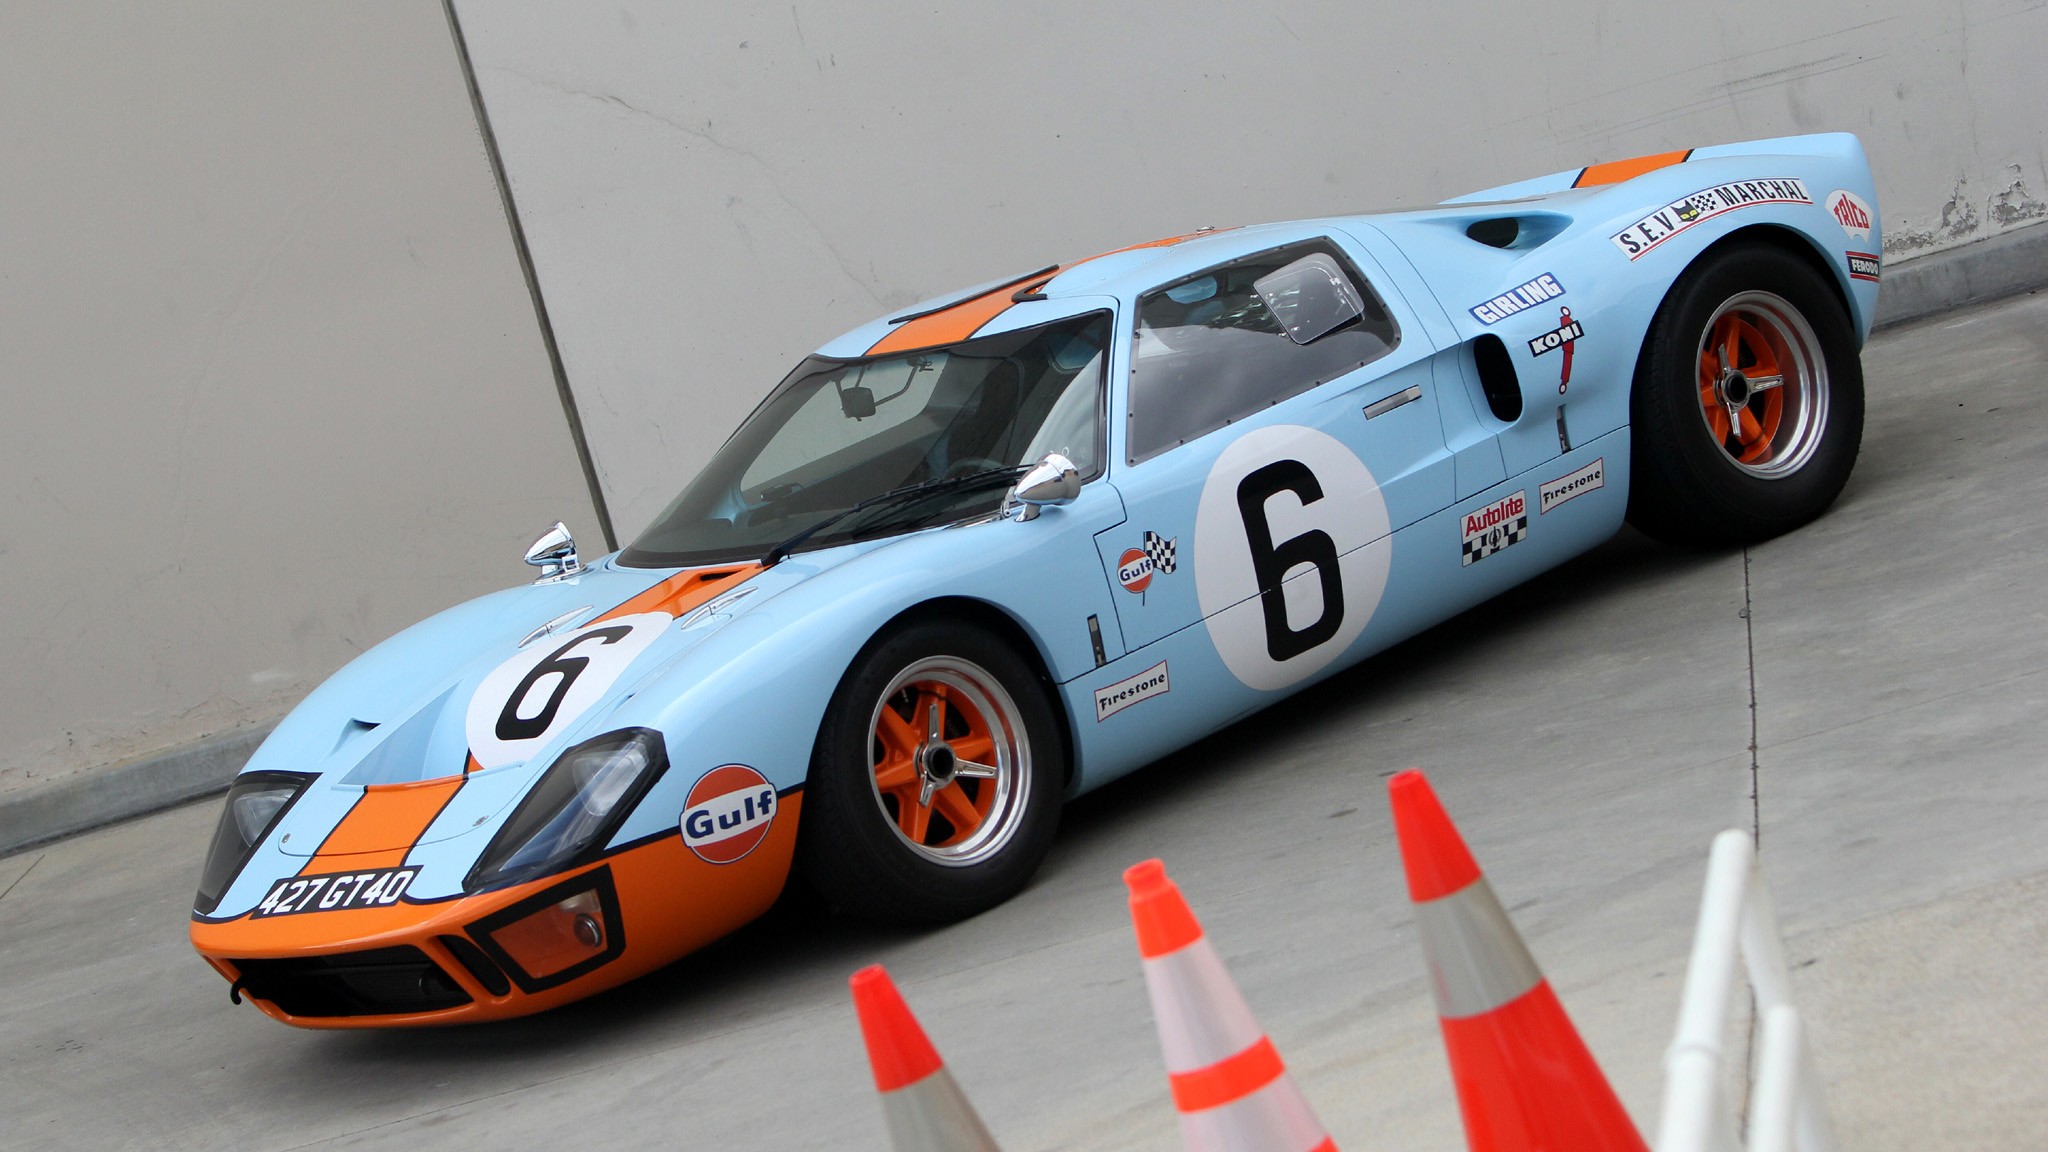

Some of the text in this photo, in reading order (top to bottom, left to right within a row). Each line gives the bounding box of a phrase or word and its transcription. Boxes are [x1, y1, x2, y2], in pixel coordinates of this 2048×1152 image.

[1714, 180, 1808, 207] MARCHAL
[1833, 193, 1870, 229] TRICO
[1851, 258, 1879, 275] FERODO
[1473, 274, 1563, 324] GIRLING
[1531, 323, 1581, 355] KONI
[1542, 470, 1601, 506] Firestone
[1465, 497, 1524, 538] Autolite
[1119, 559, 1152, 583] Gulf
[1237, 459, 1345, 662] 6
[495, 624, 634, 741] 6
[1098, 673, 1166, 712] Firestone
[685, 789, 772, 839] Gulf
[259, 870, 415, 915] 427 GT40
